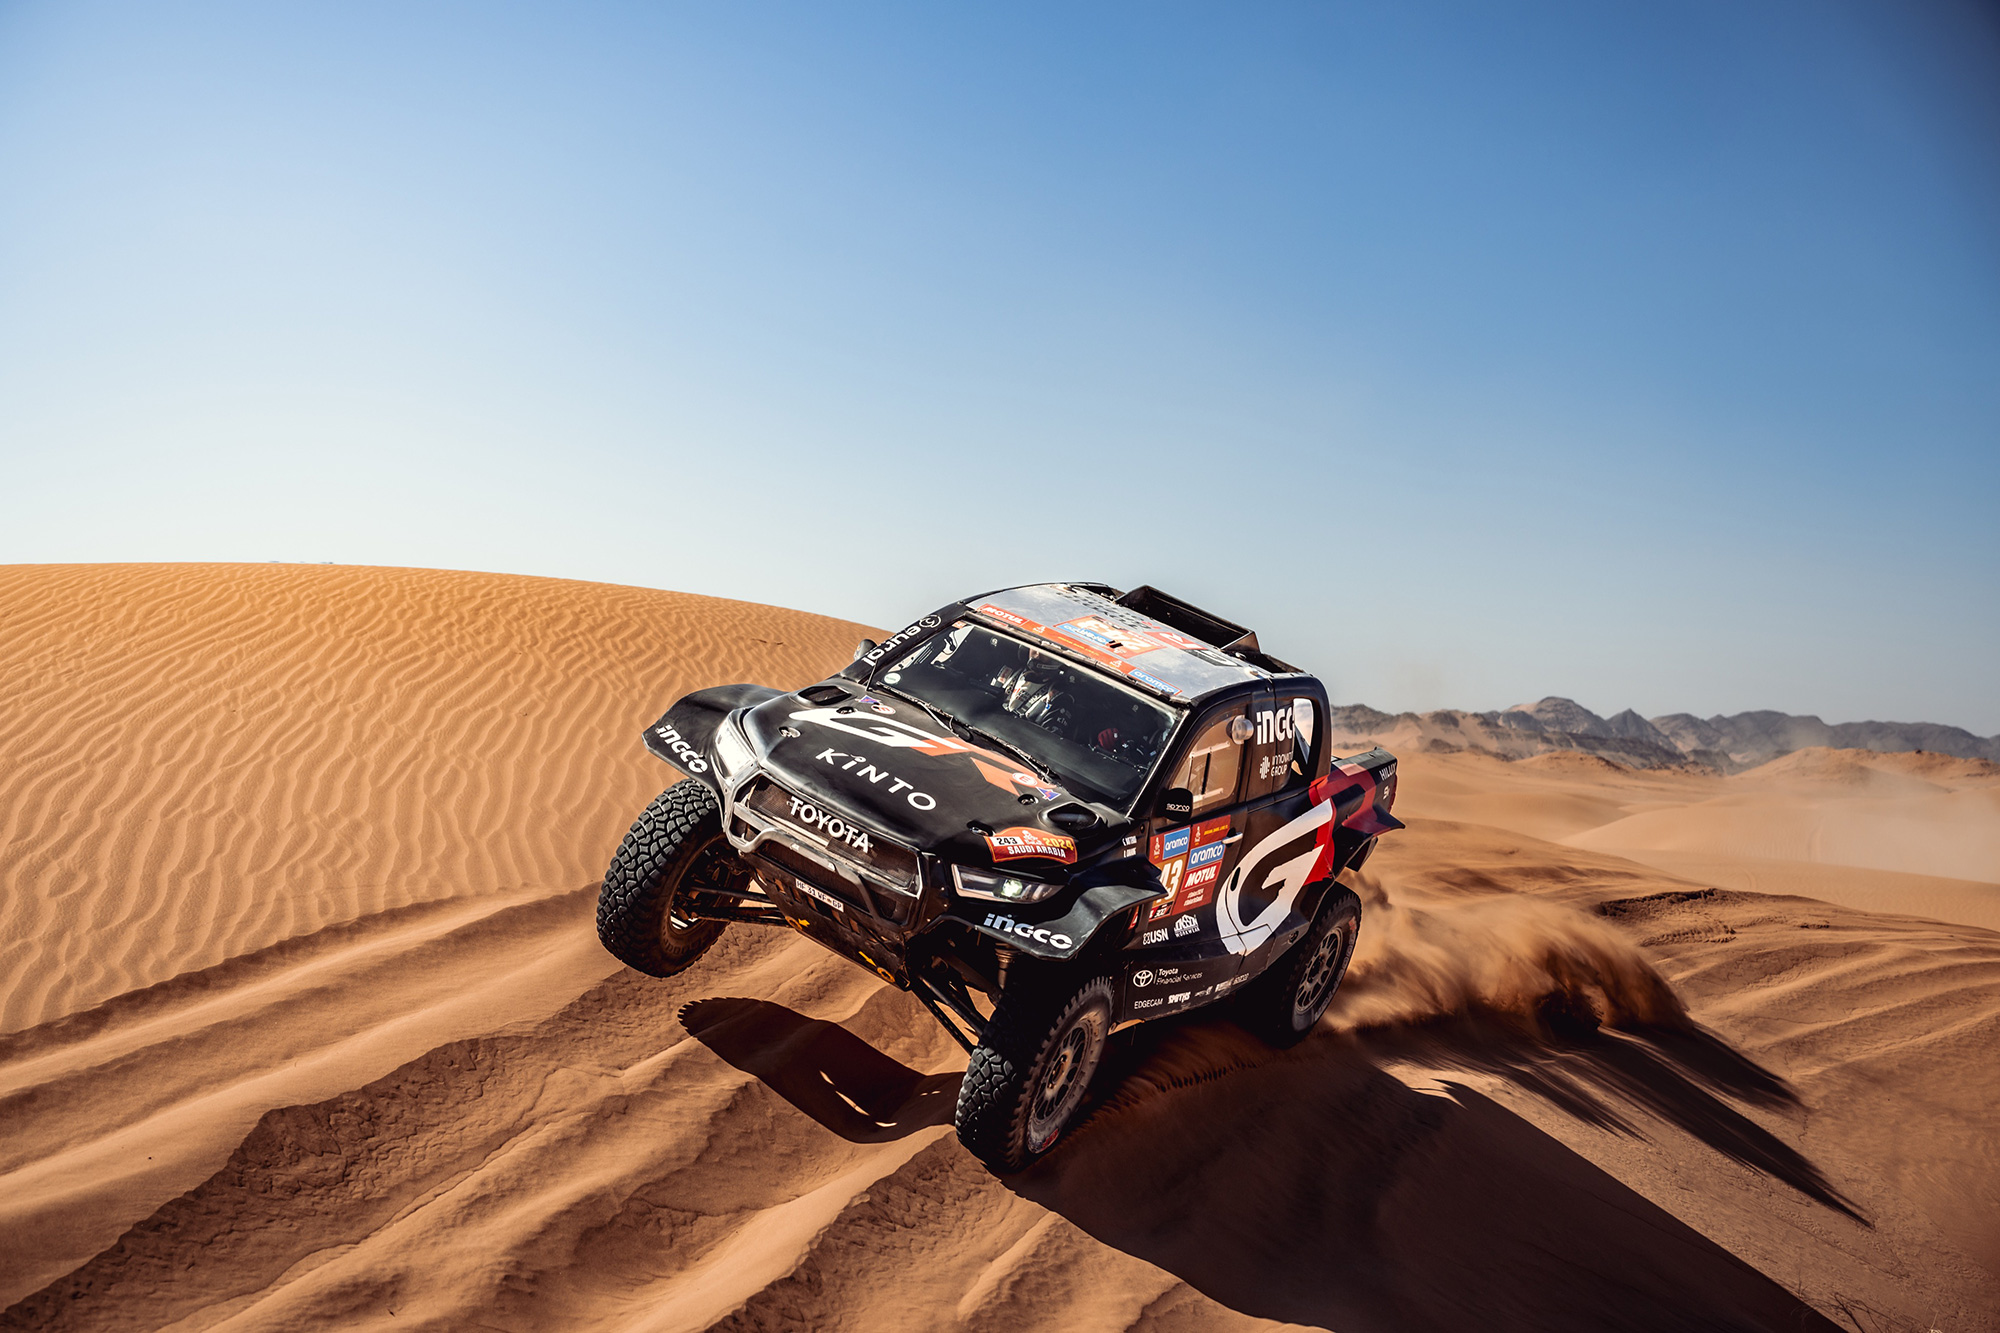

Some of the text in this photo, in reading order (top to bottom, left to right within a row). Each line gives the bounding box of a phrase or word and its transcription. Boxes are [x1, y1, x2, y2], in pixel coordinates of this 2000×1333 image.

[983, 606, 1023, 625] MOTUL
[861, 625, 922, 667] eurol
[1133, 669, 1176, 695] aramco
[1271, 764, 1288, 777] GROUP
[790, 796, 871, 853] TOYOTA
[996, 837, 1018, 846] 243
[1043, 837, 1074, 851] 2024
[1007, 845, 1066, 858] SAUDI ARABIA
[1164, 836, 1188, 851] aramco
[1190, 844, 1223, 865] aramco
[1156, 859, 1184, 903] 43
[1184, 865, 1217, 888] MOTUL
[1151, 928, 1169, 944] USN
[1159, 968, 1179, 977] Toyota
[1134, 998, 1164, 1010] EDGECAM
